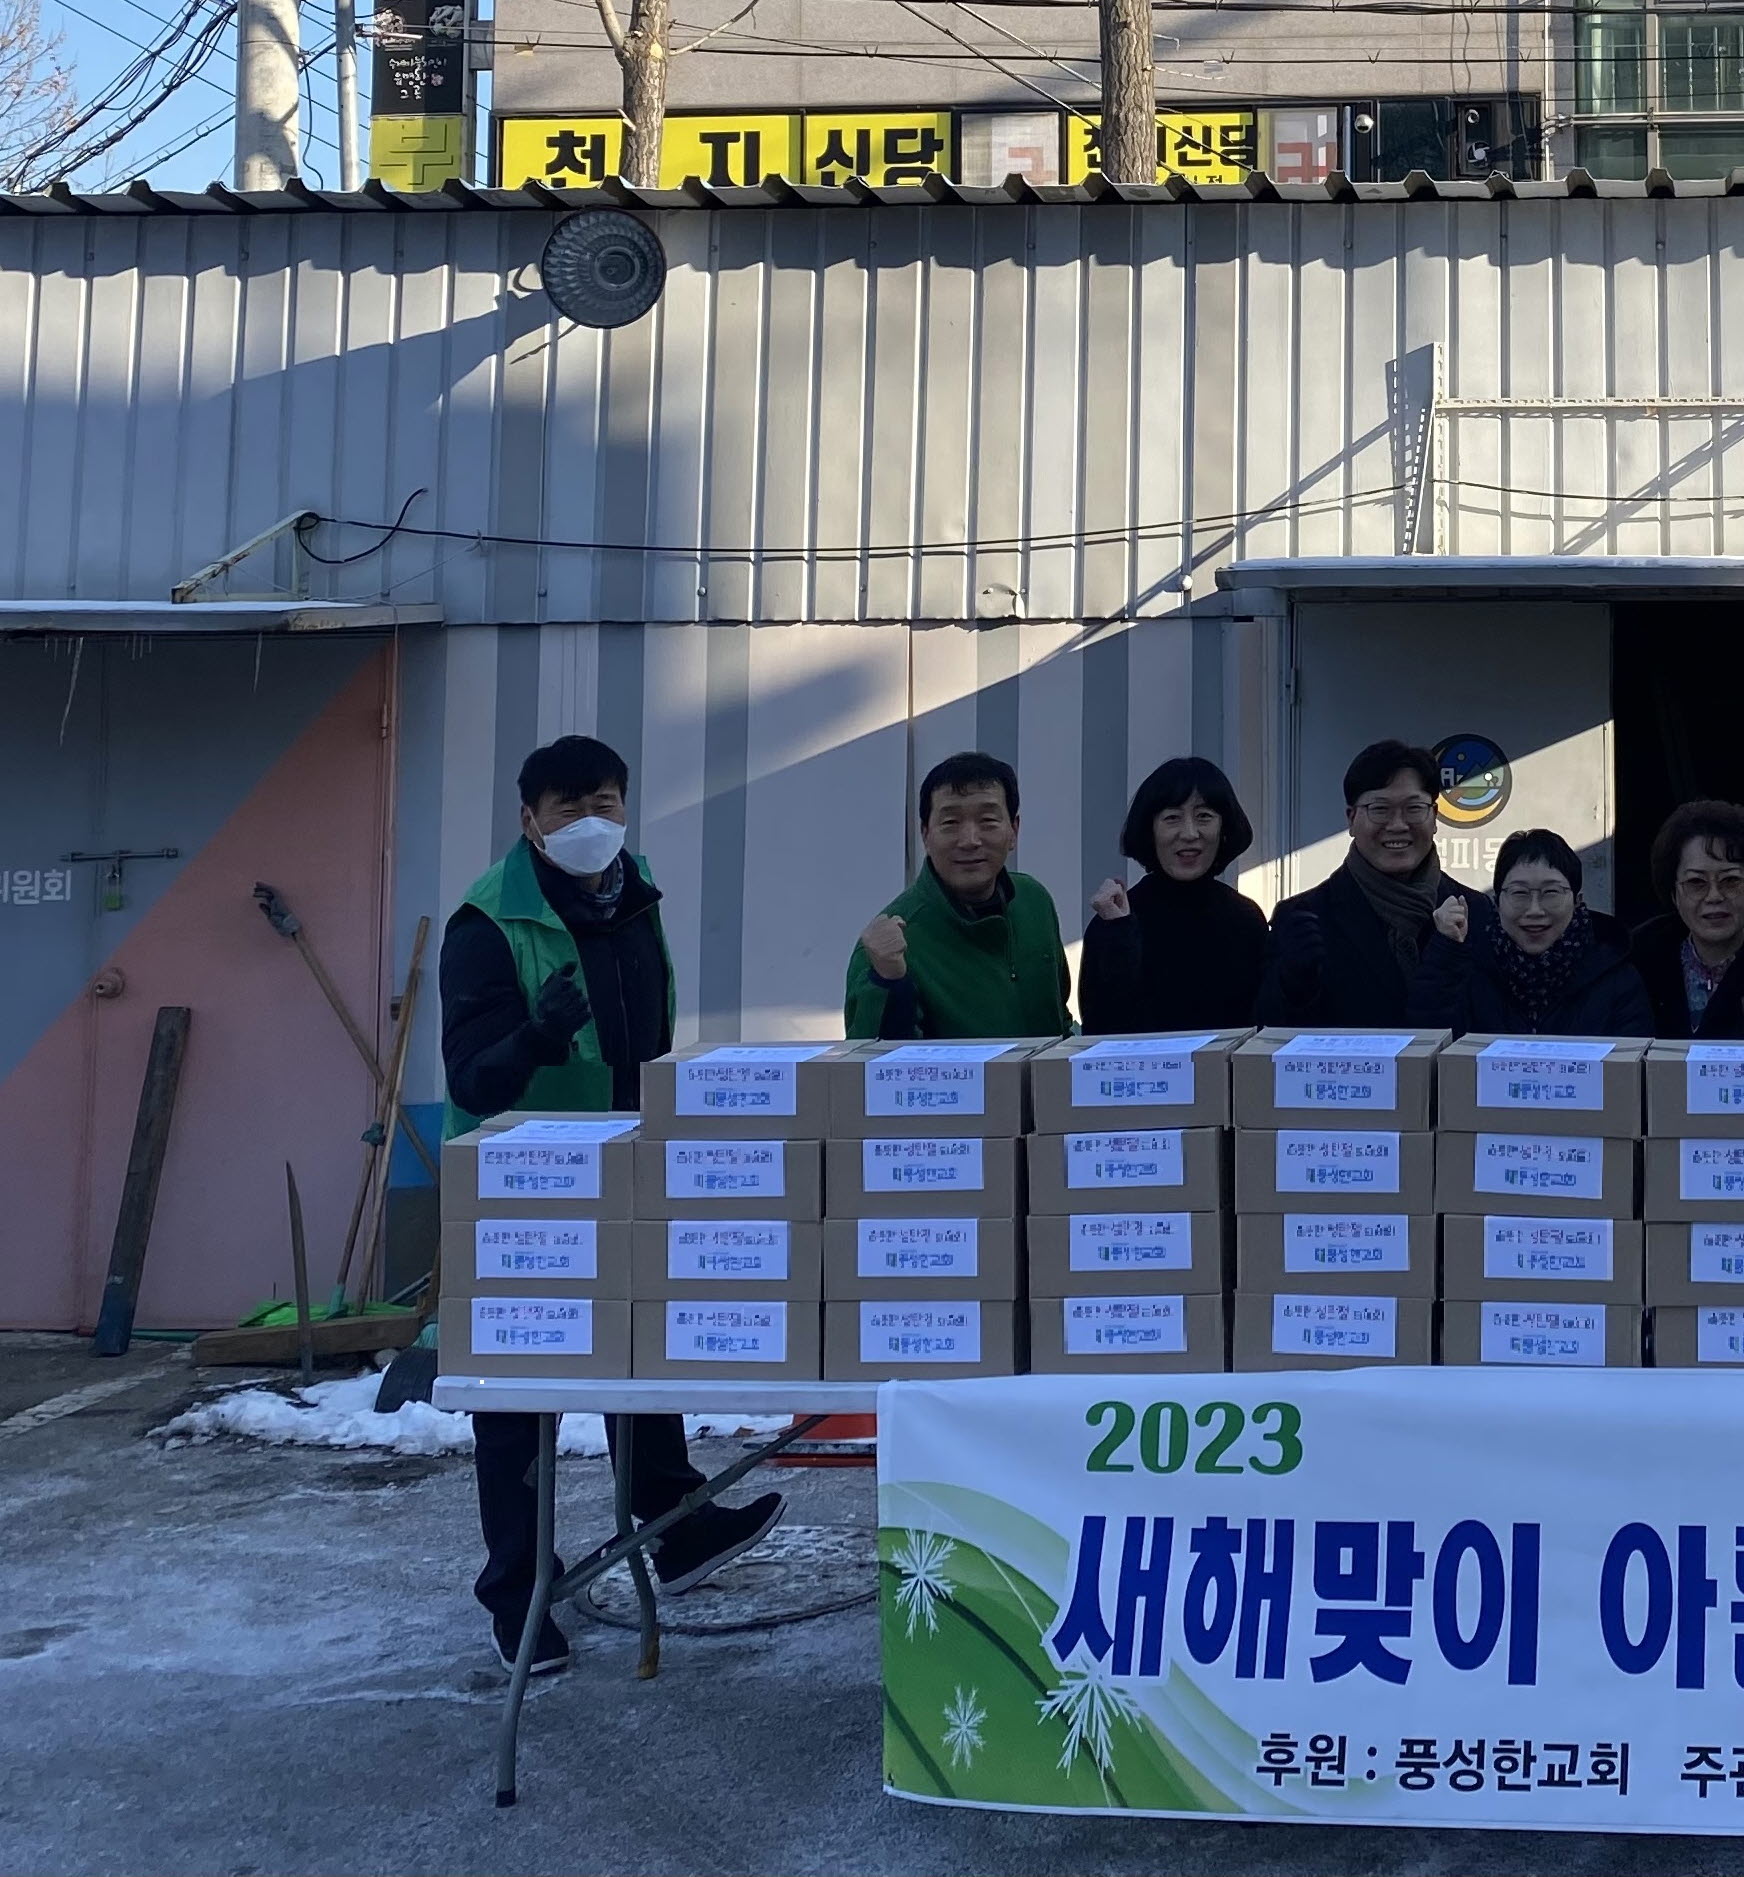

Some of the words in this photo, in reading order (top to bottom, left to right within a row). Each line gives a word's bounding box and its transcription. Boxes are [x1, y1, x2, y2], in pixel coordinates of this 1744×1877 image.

[1085, 1400, 1304, 1475] 2023
[1053, 1514, 1541, 1686] 새해맞이
[1256, 1732, 1348, 1787] 후원
[1394, 1737, 1630, 1796] 풍성한교회
